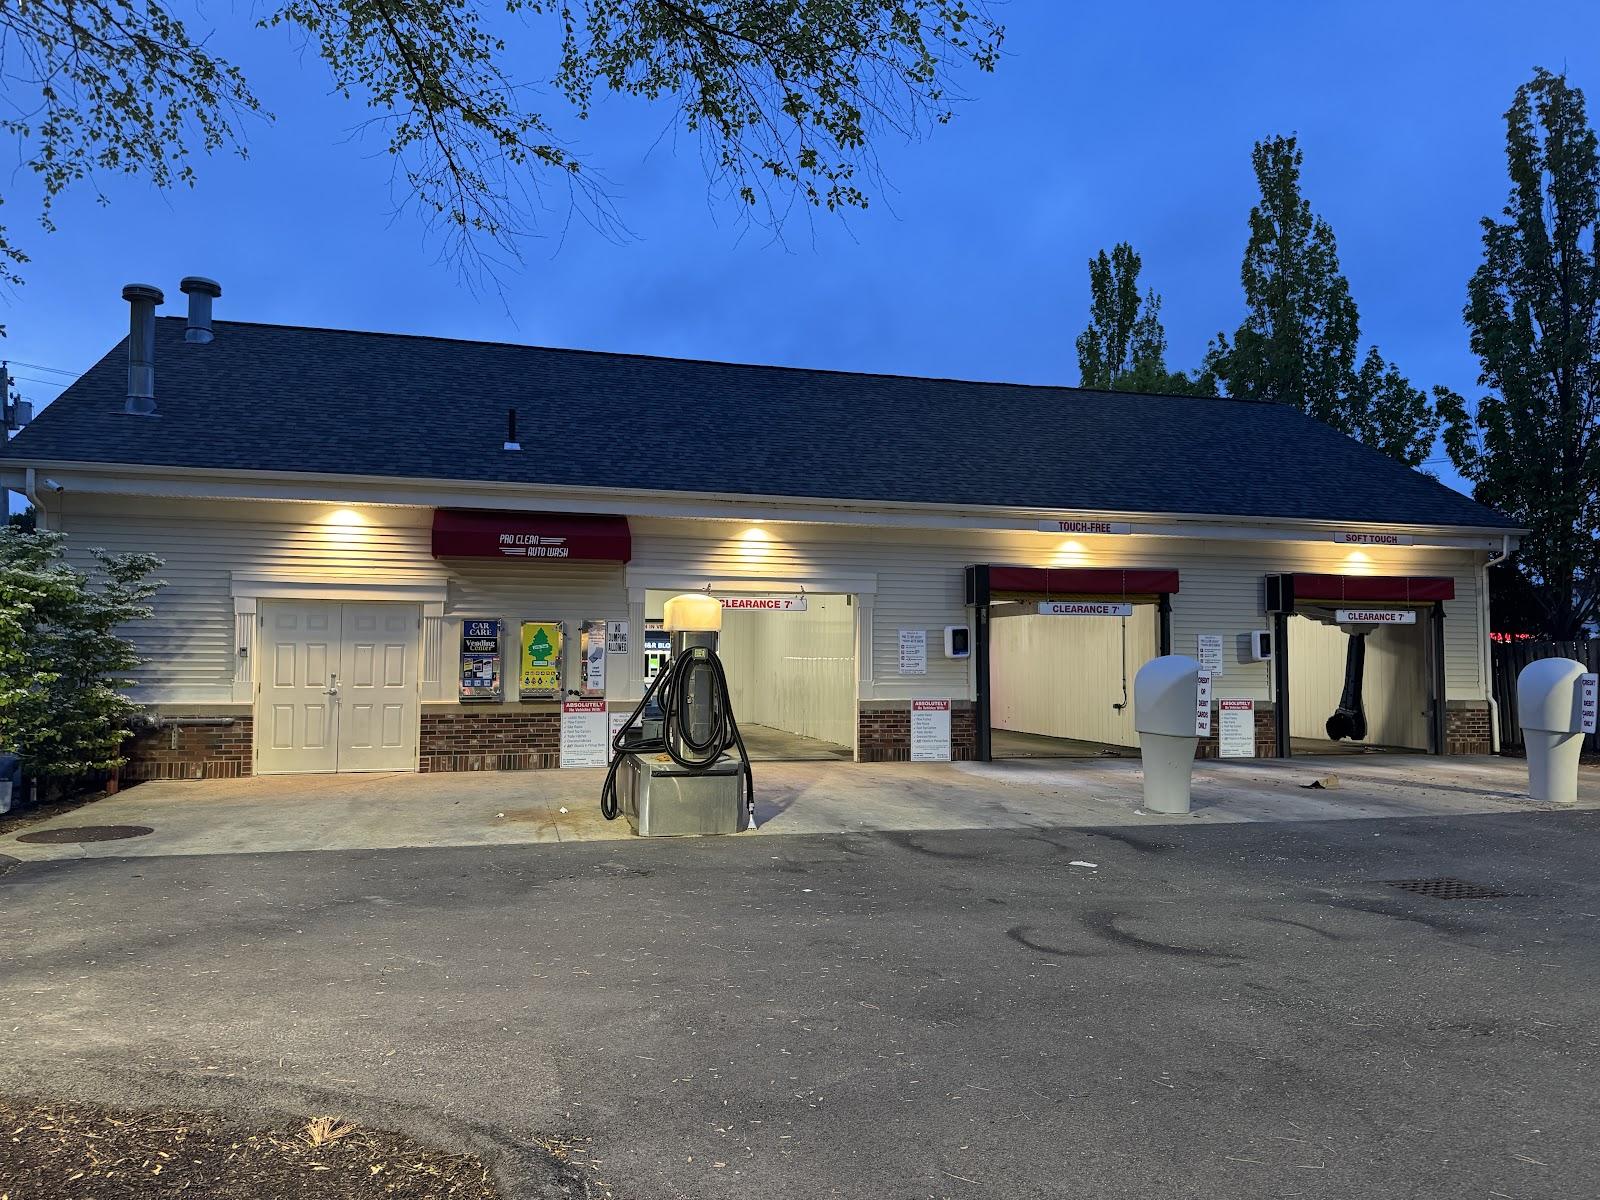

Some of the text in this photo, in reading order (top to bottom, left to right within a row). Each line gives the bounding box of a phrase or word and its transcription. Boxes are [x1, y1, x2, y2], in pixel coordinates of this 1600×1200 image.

[1058, 521, 1111, 533] TOUCH-FREE
[499, 534, 540, 545] PRO CLEAN
[1345, 534, 1398, 544] SOFT TOUCH
[527, 546, 569, 558] AUTO WASH
[719, 599, 793, 609] CLEARANCE 7'
[1052, 604, 1120, 614] CLEARANCE 7'
[1347, 612, 1405, 621] CLEARANCE 7'
[469, 628, 493, 636] CARE
[465, 639, 496, 648] Vending
[1198, 722, 1207, 730] ONLY
